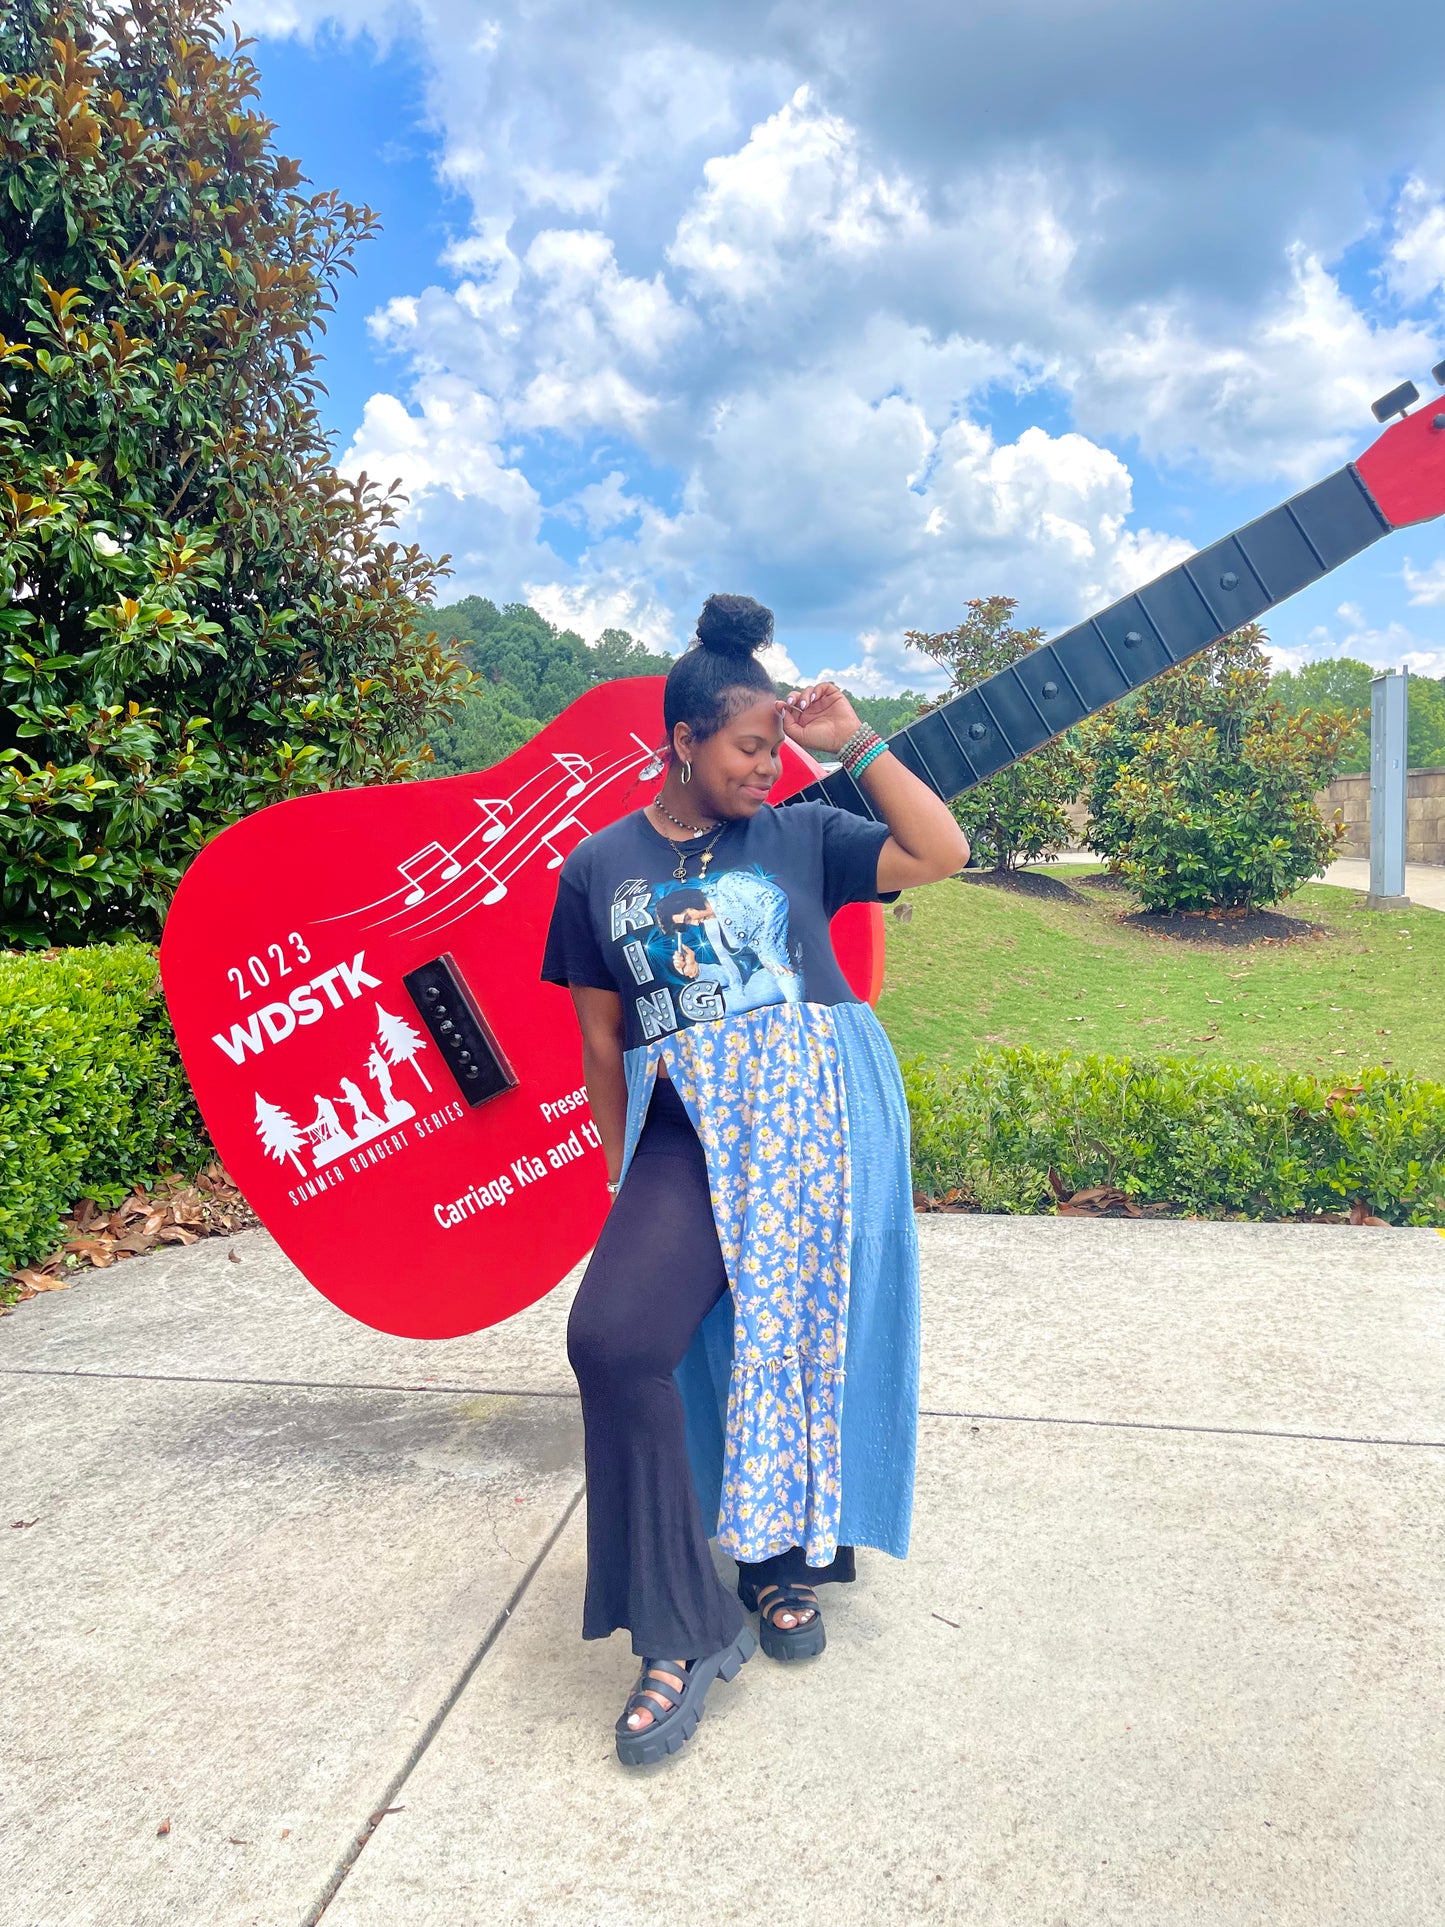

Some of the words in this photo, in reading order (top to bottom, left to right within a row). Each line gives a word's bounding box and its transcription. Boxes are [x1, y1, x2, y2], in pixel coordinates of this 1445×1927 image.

[614, 878, 649, 903] The
[211, 950, 383, 1066] WDSTK
[227, 931, 312, 1001] 2023
[611, 893, 727, 1041] KING
[288, 1166, 345, 1207] SUMMER
[349, 1130, 411, 1174] CONCERT
[414, 1101, 465, 1139] SERIES
[433, 1175, 515, 1230] Carriage
[510, 1155, 549, 1188] Kia
[546, 1129, 586, 1170] and
